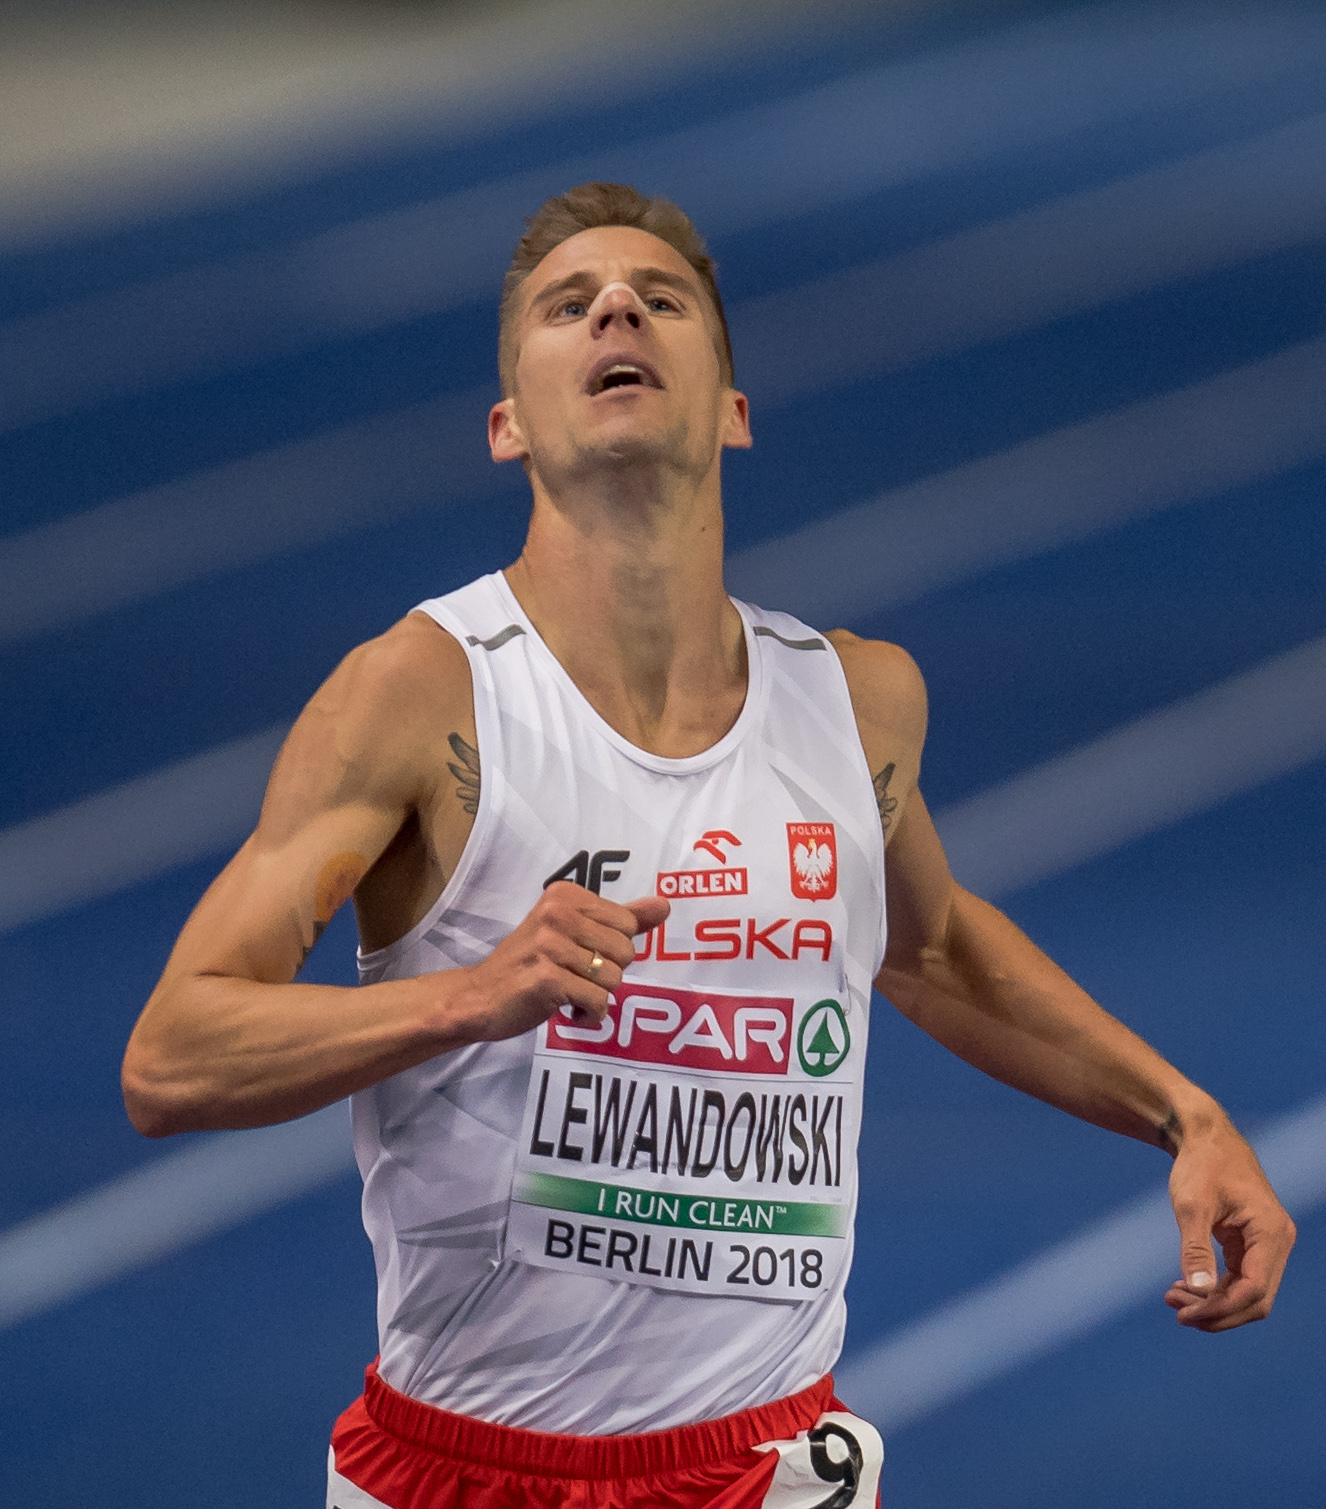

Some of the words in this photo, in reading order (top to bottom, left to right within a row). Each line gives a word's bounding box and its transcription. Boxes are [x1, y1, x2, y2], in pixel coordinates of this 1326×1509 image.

[789, 825, 833, 836] POLSKA
[659, 871, 743, 895] ORLEN
[633, 917, 833, 962] LSKA
[529, 1069, 844, 1188] LEWANDOWSKI
[597, 1188, 606, 1212] I
[614, 1190, 680, 1223] RUN
[543, 1218, 714, 1282] BERLIN
[726, 1244, 823, 1289] 2018
